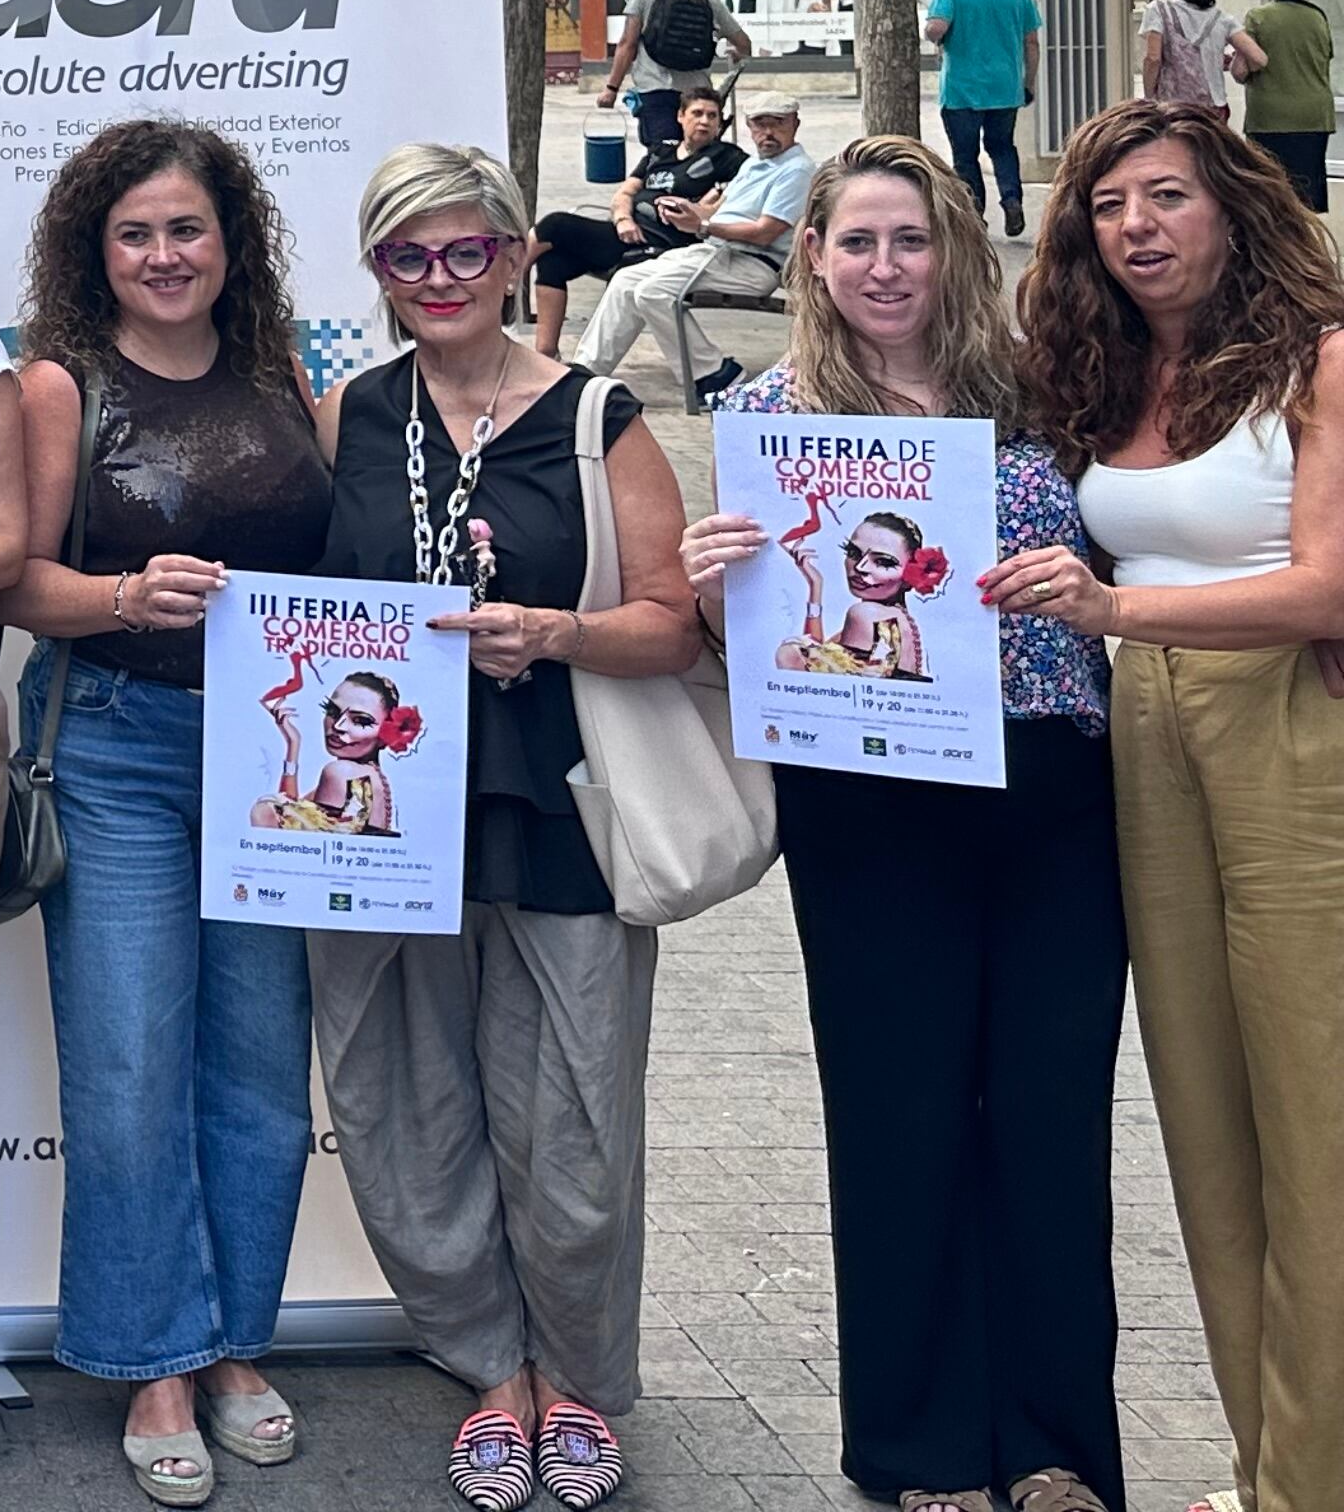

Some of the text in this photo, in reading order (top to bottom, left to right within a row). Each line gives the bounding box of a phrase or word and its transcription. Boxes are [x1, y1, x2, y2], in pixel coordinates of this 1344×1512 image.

[119, 50, 350, 96] advertising
[269, 114, 342, 132] Exterior
[272, 137, 351, 155] Eventos
[760, 435, 936, 463] III FERIA DE
[776, 456, 931, 484] COMERCIO
[777, 478, 932, 502] TRADICIONAL
[249, 594, 415, 626] III FERIA DE
[263, 616, 410, 646] COMERCIO
[263, 637, 410, 663] TRADICIONAL
[769, 680, 851, 699] En septiembre
[861, 684, 873, 695] 18
[862, 699, 874, 709] 19
[877, 702, 884, 711] y
[887, 701, 902, 712] 20
[241, 839, 321, 856] En septiembre
[332, 841, 343, 851] 18
[332, 855, 343, 865] 19
[346, 858, 353, 867] y
[355, 856, 369, 867] 20
